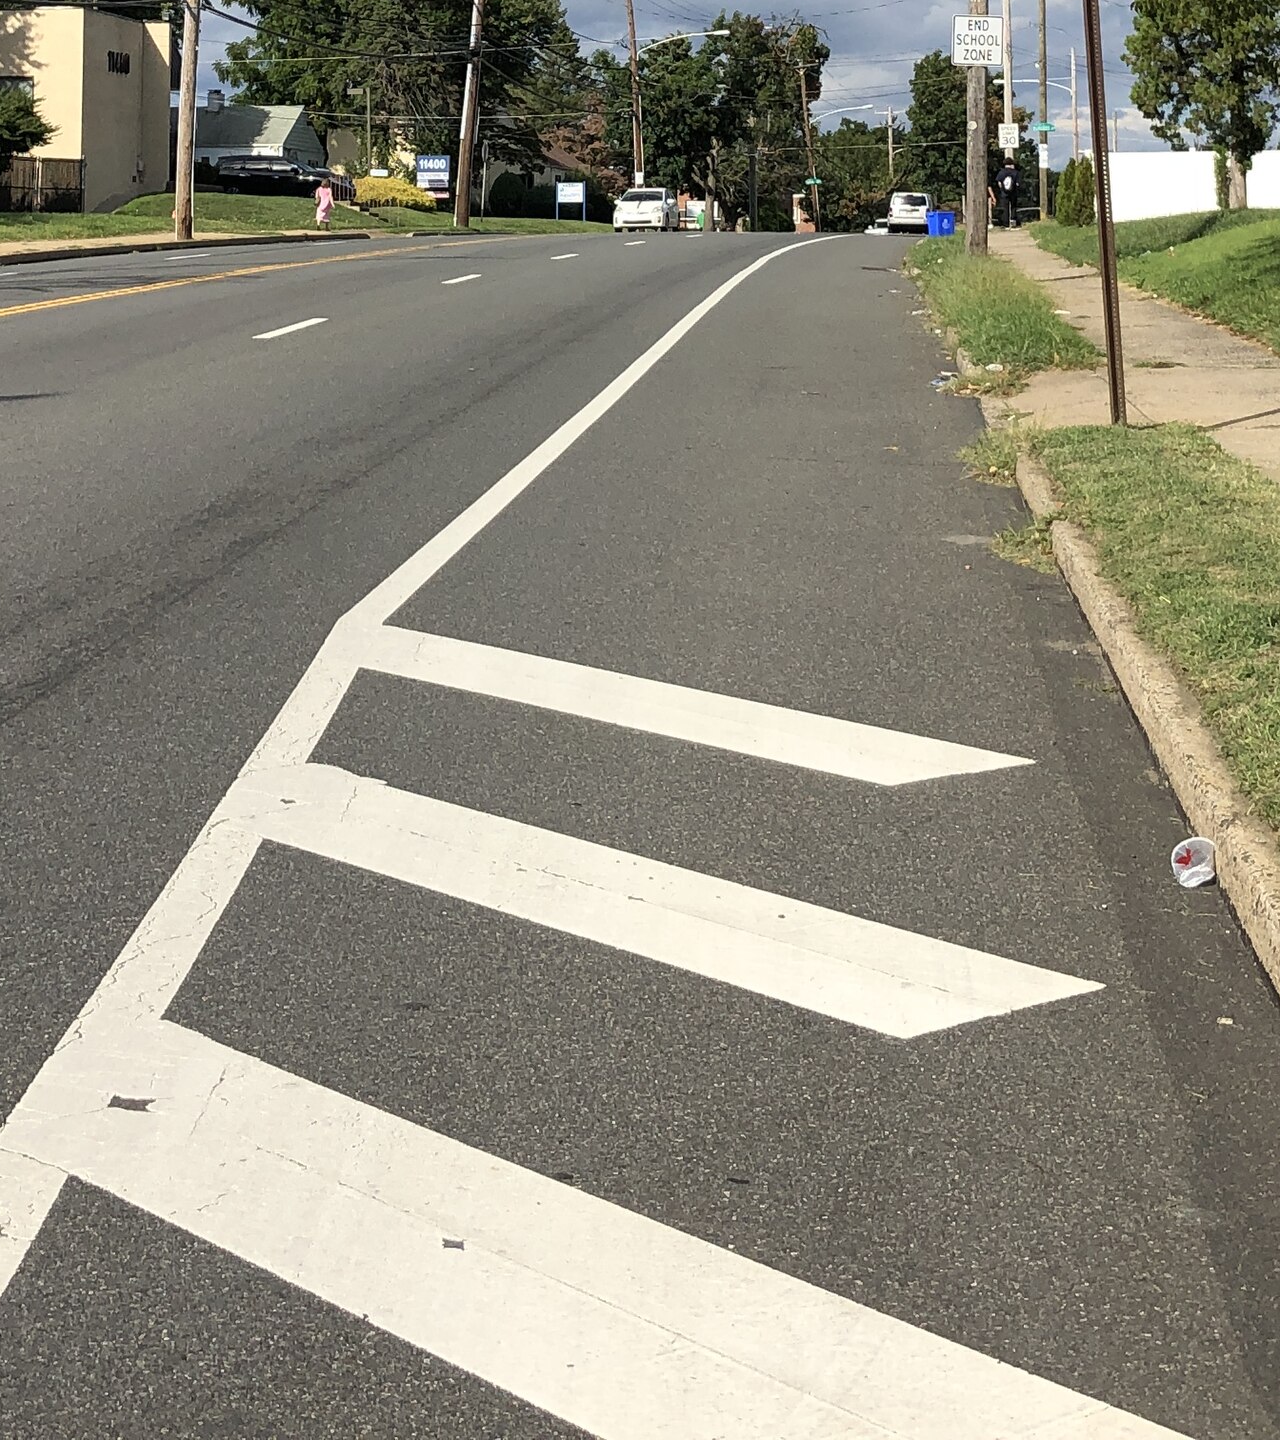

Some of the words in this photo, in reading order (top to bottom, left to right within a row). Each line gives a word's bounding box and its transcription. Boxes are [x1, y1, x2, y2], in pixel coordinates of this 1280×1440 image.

[967, 19, 990, 32] END
[955, 34, 1000, 47] SCHOOL
[963, 49, 993, 61] ZONE
[1001, 136, 1016, 146] 30
[419, 158, 447, 170] 11400
